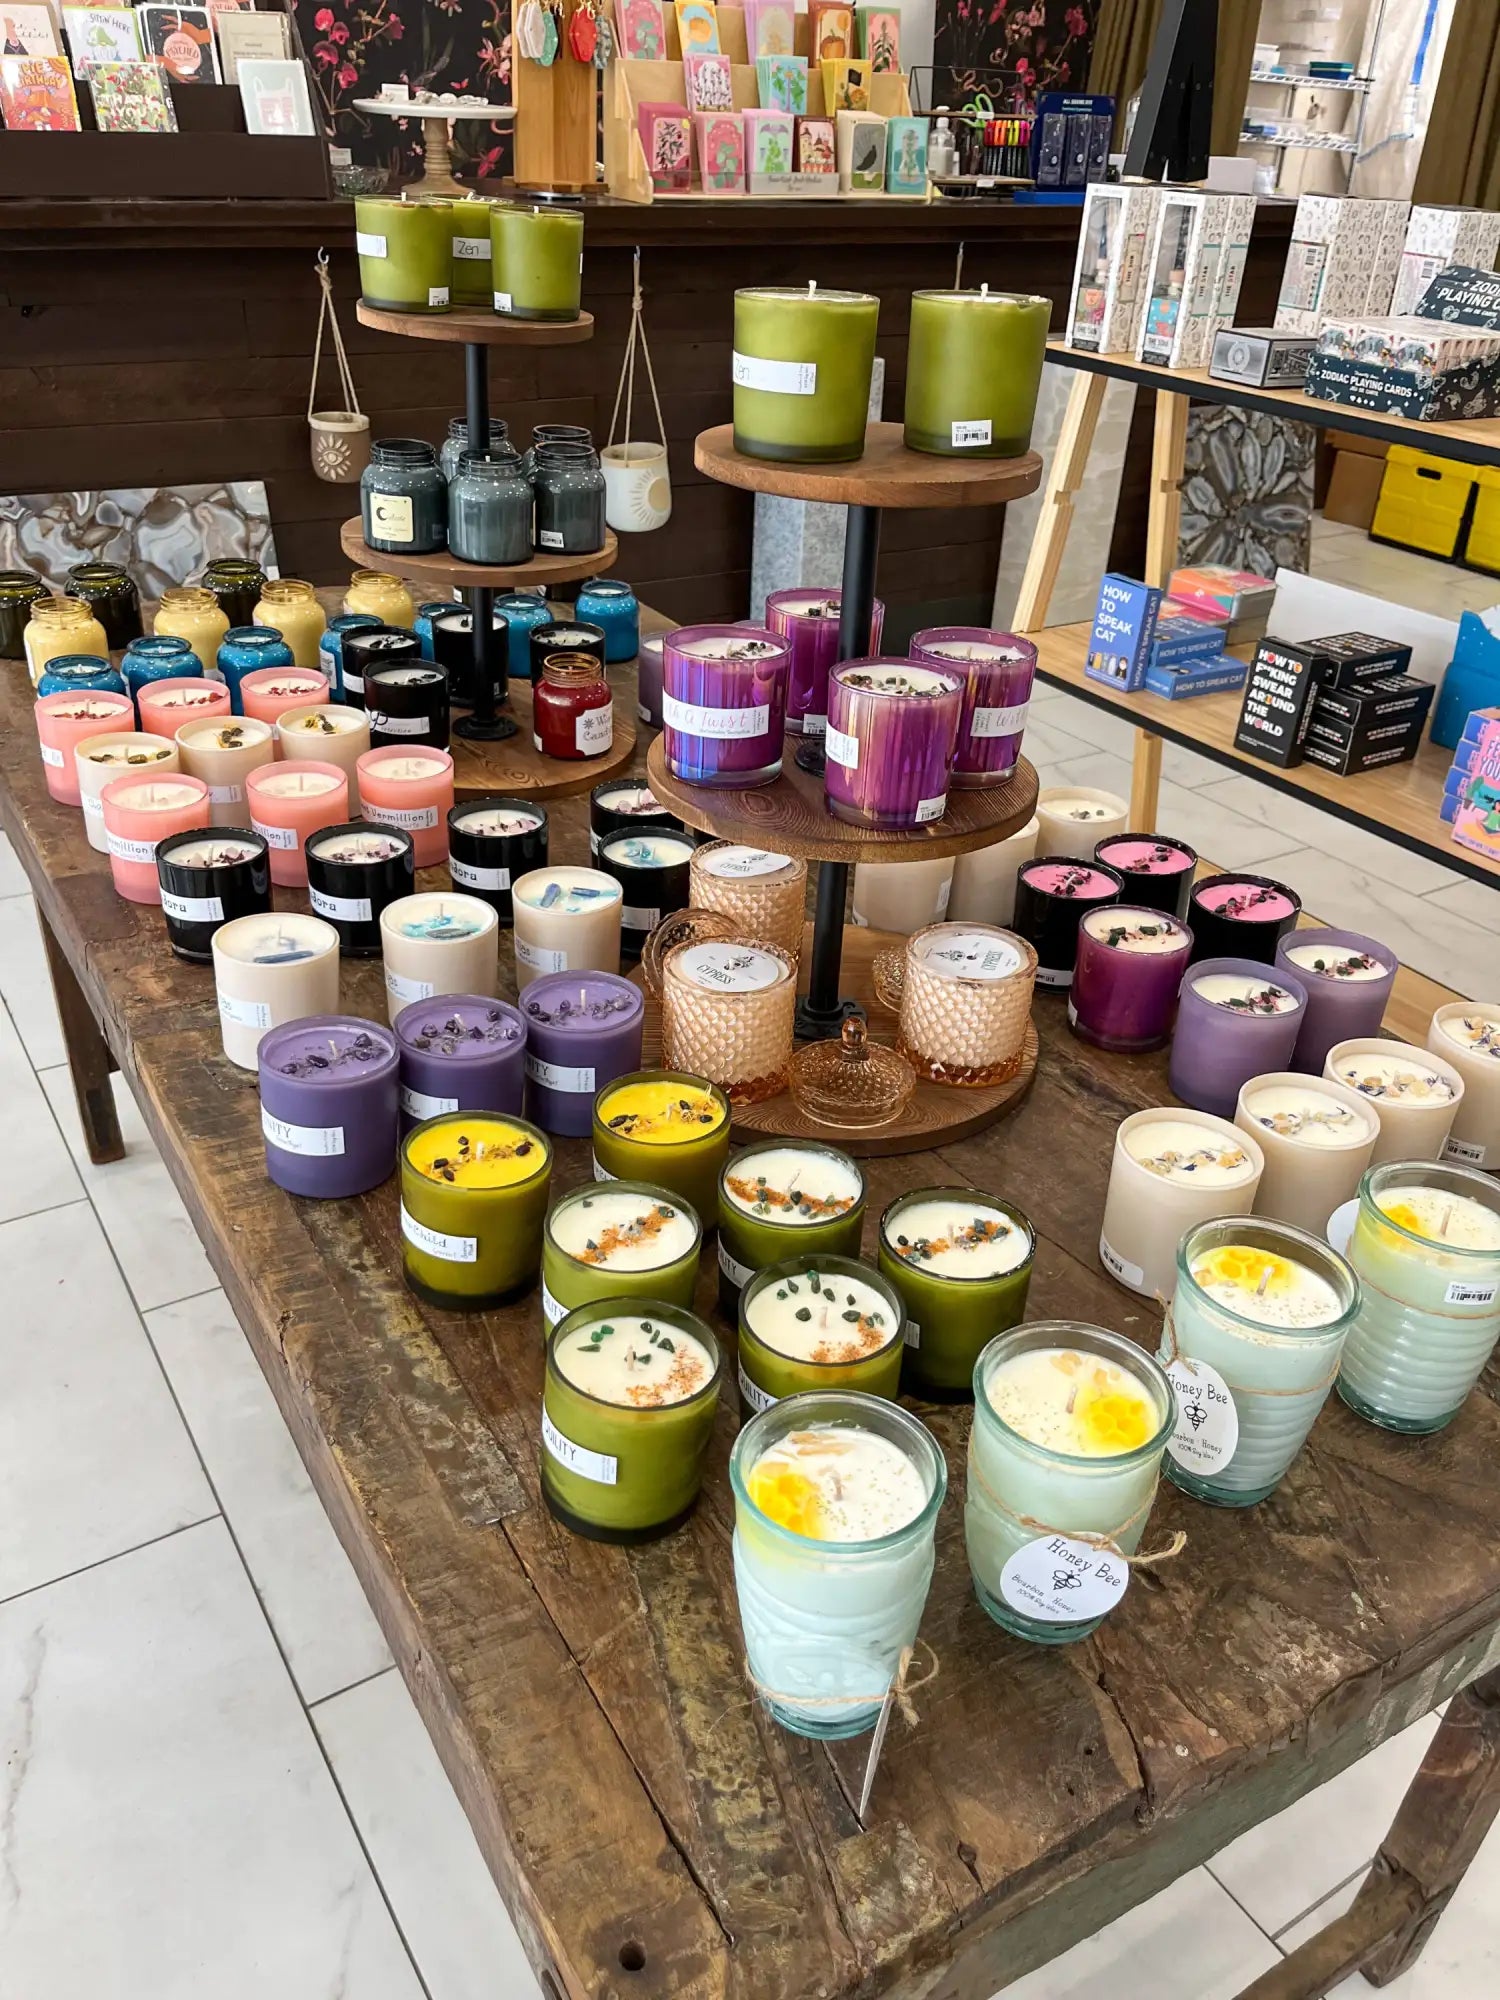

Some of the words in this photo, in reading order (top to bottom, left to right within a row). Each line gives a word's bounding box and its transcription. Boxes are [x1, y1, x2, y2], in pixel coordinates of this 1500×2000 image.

[457, 241, 479, 255] Zen
[1437, 288, 1493, 308] PLAYING
[1320, 370, 1349, 384] ZODIAC
[1350, 376, 1384, 391] PLAYING
[1384, 384, 1413, 398] CARDS
[1103, 585, 1132, 604] HOW
[1101, 600, 1116, 613] TO
[1149, 596, 1158, 615] CAT
[1098, 613, 1133, 635] SPEAK
[1095, 628, 1117, 643] CAT
[1159, 647, 1177, 658] HOW
[1177, 647, 1187, 655] TO
[1187, 643, 1208, 653] SPEAK
[1208, 639, 1222, 648] CAT
[1258, 649, 1286, 668] HOW
[1286, 659, 1303, 673] TO
[1175, 681, 1194, 692] HOW
[1194, 680, 1206, 688] TO
[1206, 677, 1229, 687] SPEAK
[1229, 674, 1244, 683] CAT
[1252, 675, 1293, 699] SWEAR
[1247, 701, 1269, 717] THE
[1249, 688, 1296, 714] AROUND
[1243, 713, 1284, 737] WORLD
[371, 808, 424, 822] Vermillion
[1207, 1383, 1228, 1404] Bee
[1202, 1439, 1222, 1454] Honey
[1047, 1538, 1093, 1573] Honey
[1095, 1562, 1122, 1588] Bee
[1011, 1574, 1045, 1597] Bourbon
[1052, 1597, 1077, 1614] Honey
[1033, 1597, 1046, 1609] Soy
